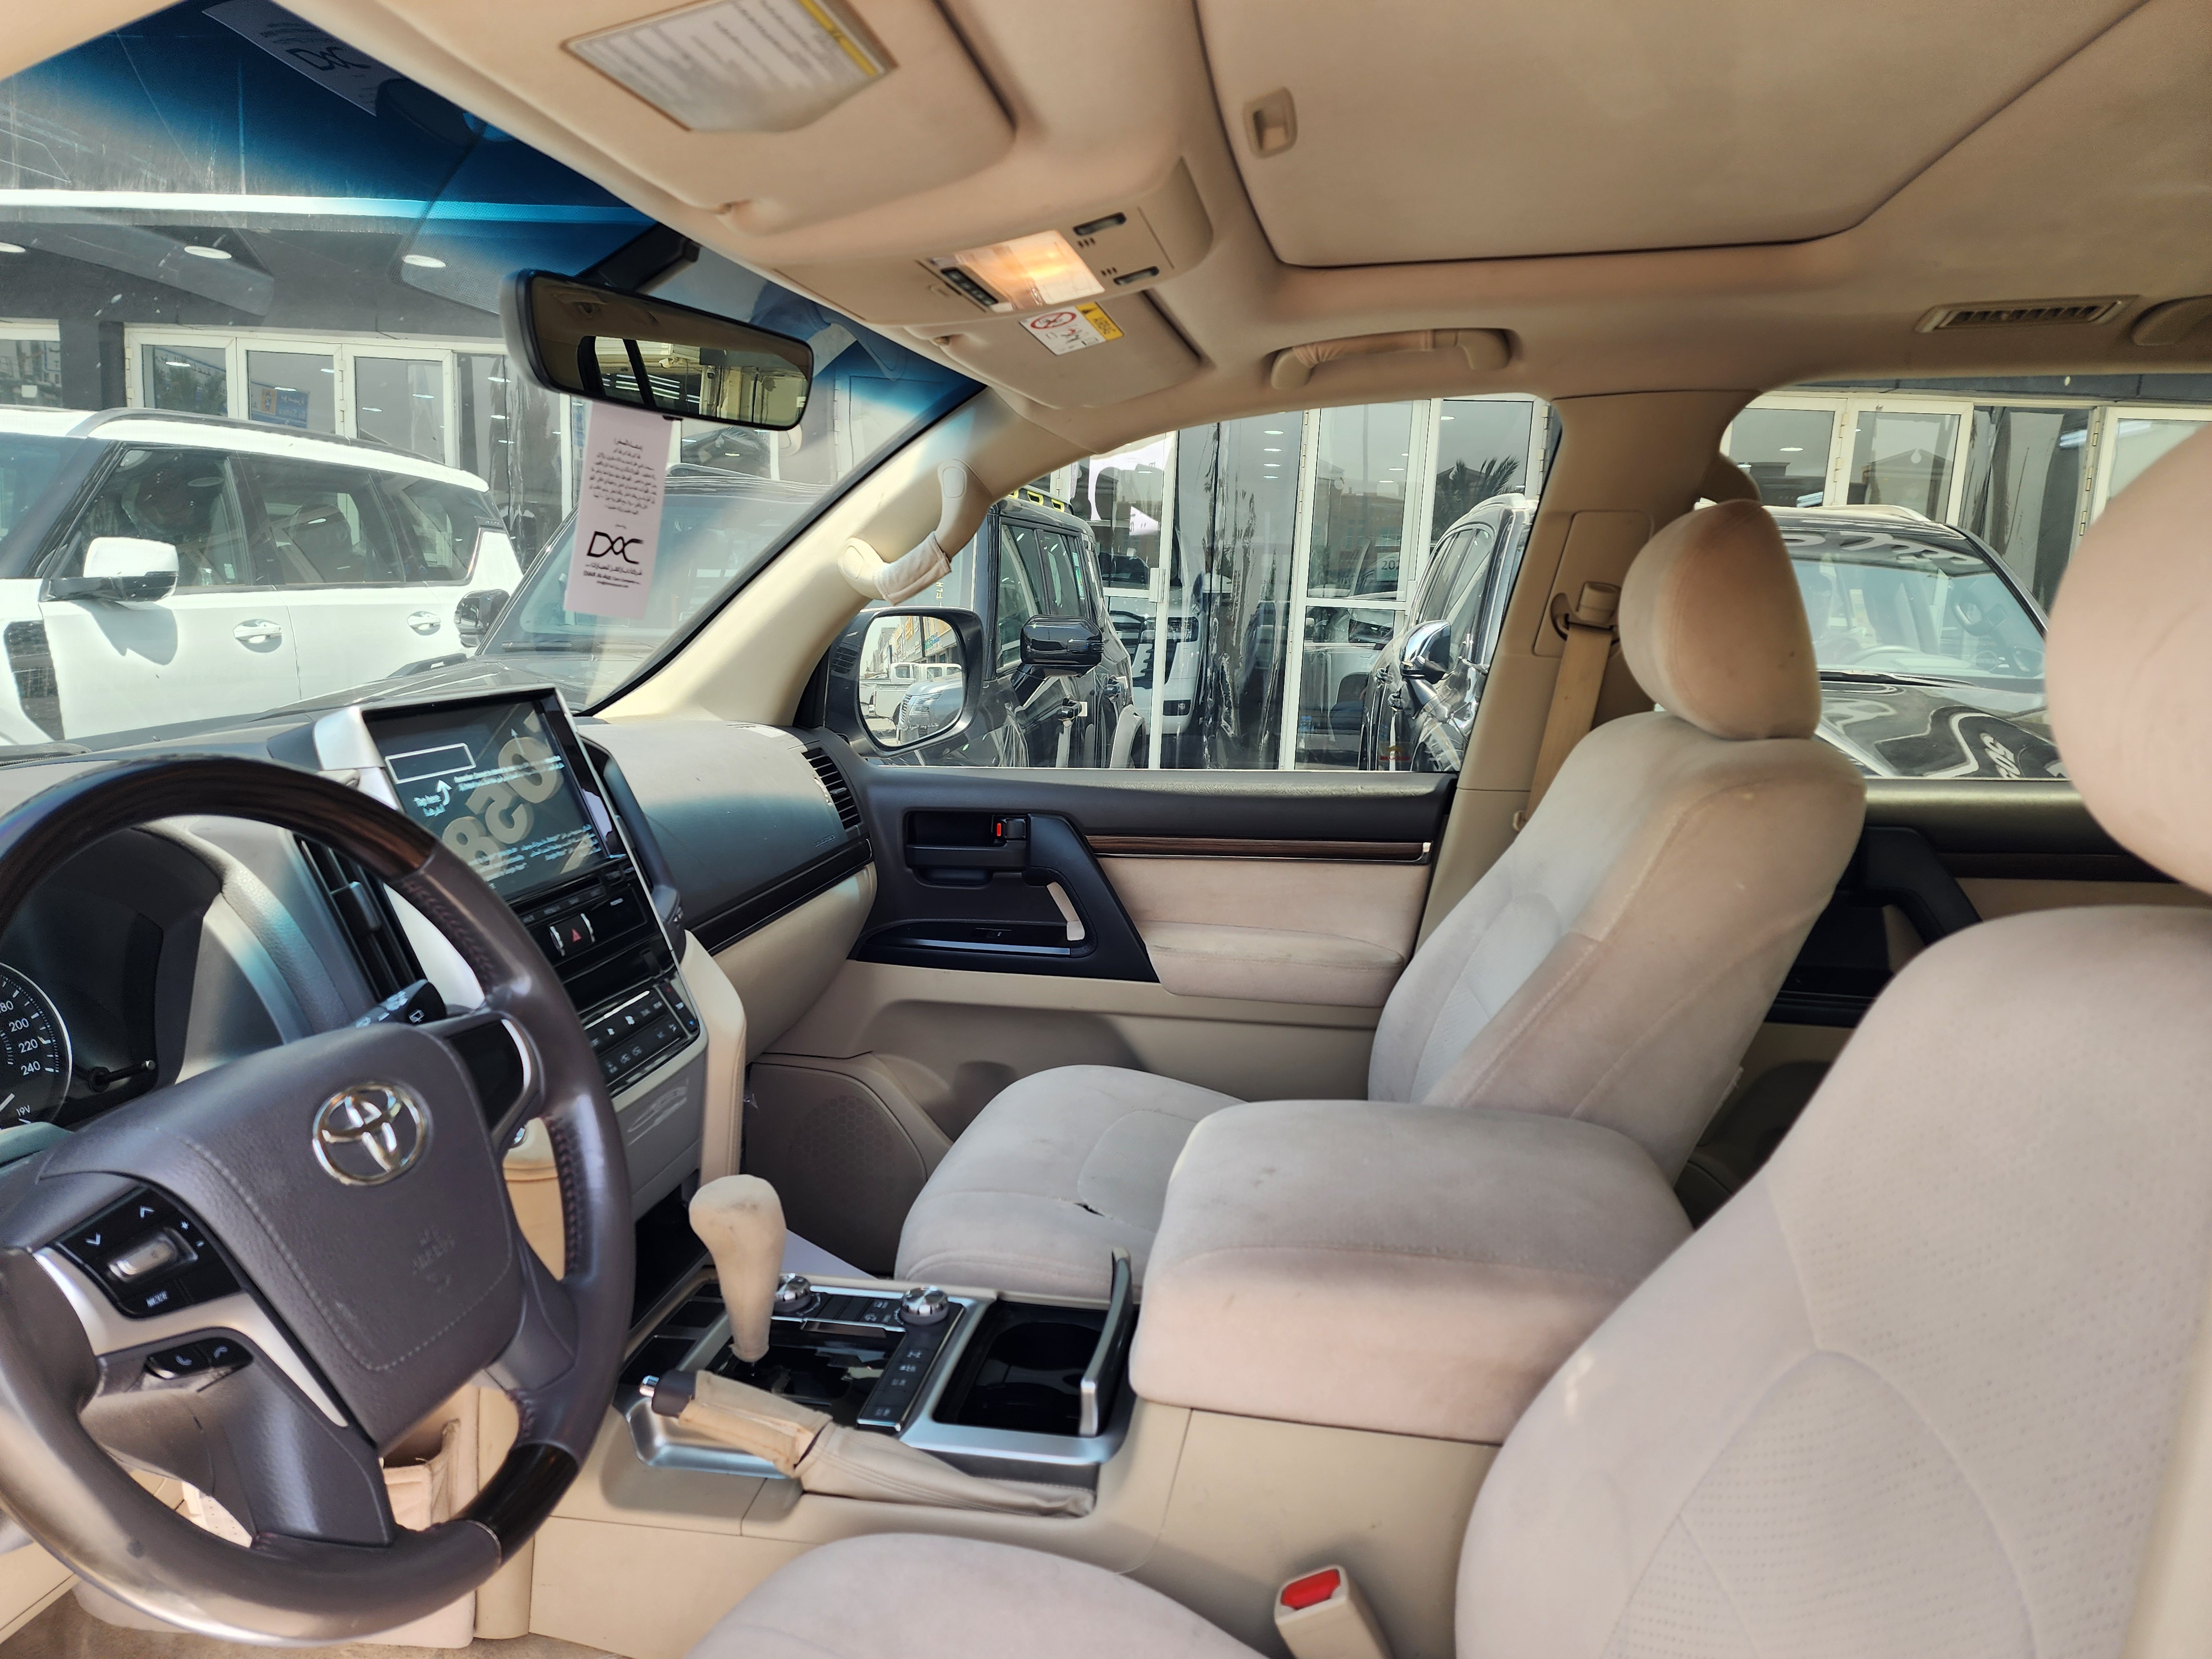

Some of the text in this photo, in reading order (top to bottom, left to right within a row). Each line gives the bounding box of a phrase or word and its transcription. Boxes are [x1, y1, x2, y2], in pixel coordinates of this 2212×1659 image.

[0, 1000, 14, 1013] 80
[8, 1018, 29, 1032] 200
[18, 1039, 38, 1053] 220
[20, 1060, 41, 1076] 240
[16, 1105, 31, 1117] 19V
